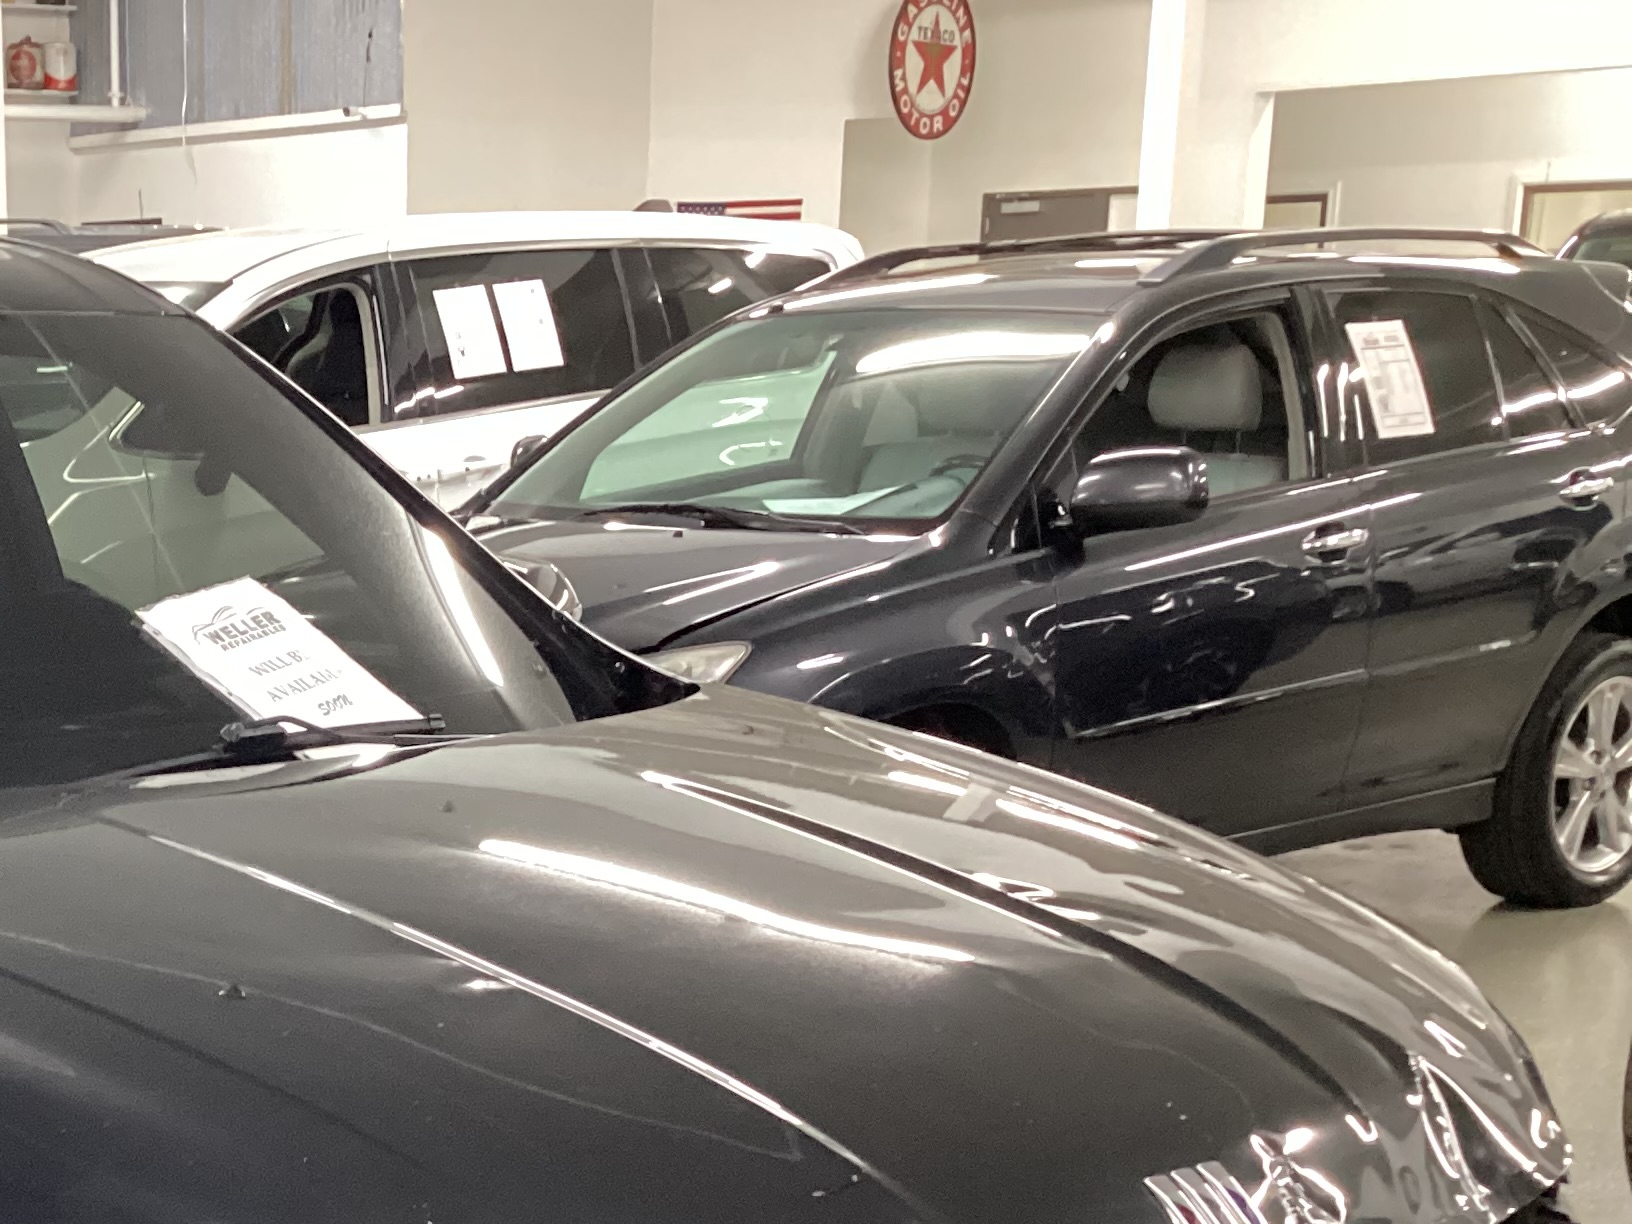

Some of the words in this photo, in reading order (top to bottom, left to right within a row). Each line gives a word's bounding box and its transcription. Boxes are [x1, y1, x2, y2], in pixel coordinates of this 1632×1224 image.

[897, 0, 972, 48] GASLINE
[893, 68, 944, 135] MOTOR
[948, 72, 971, 117] OIL
[202, 610, 282, 645] WELLER
[220, 623, 287, 652] REPAIRABLES
[248, 656, 293, 677] WILL
[266, 668, 343, 703] AVAILAL
